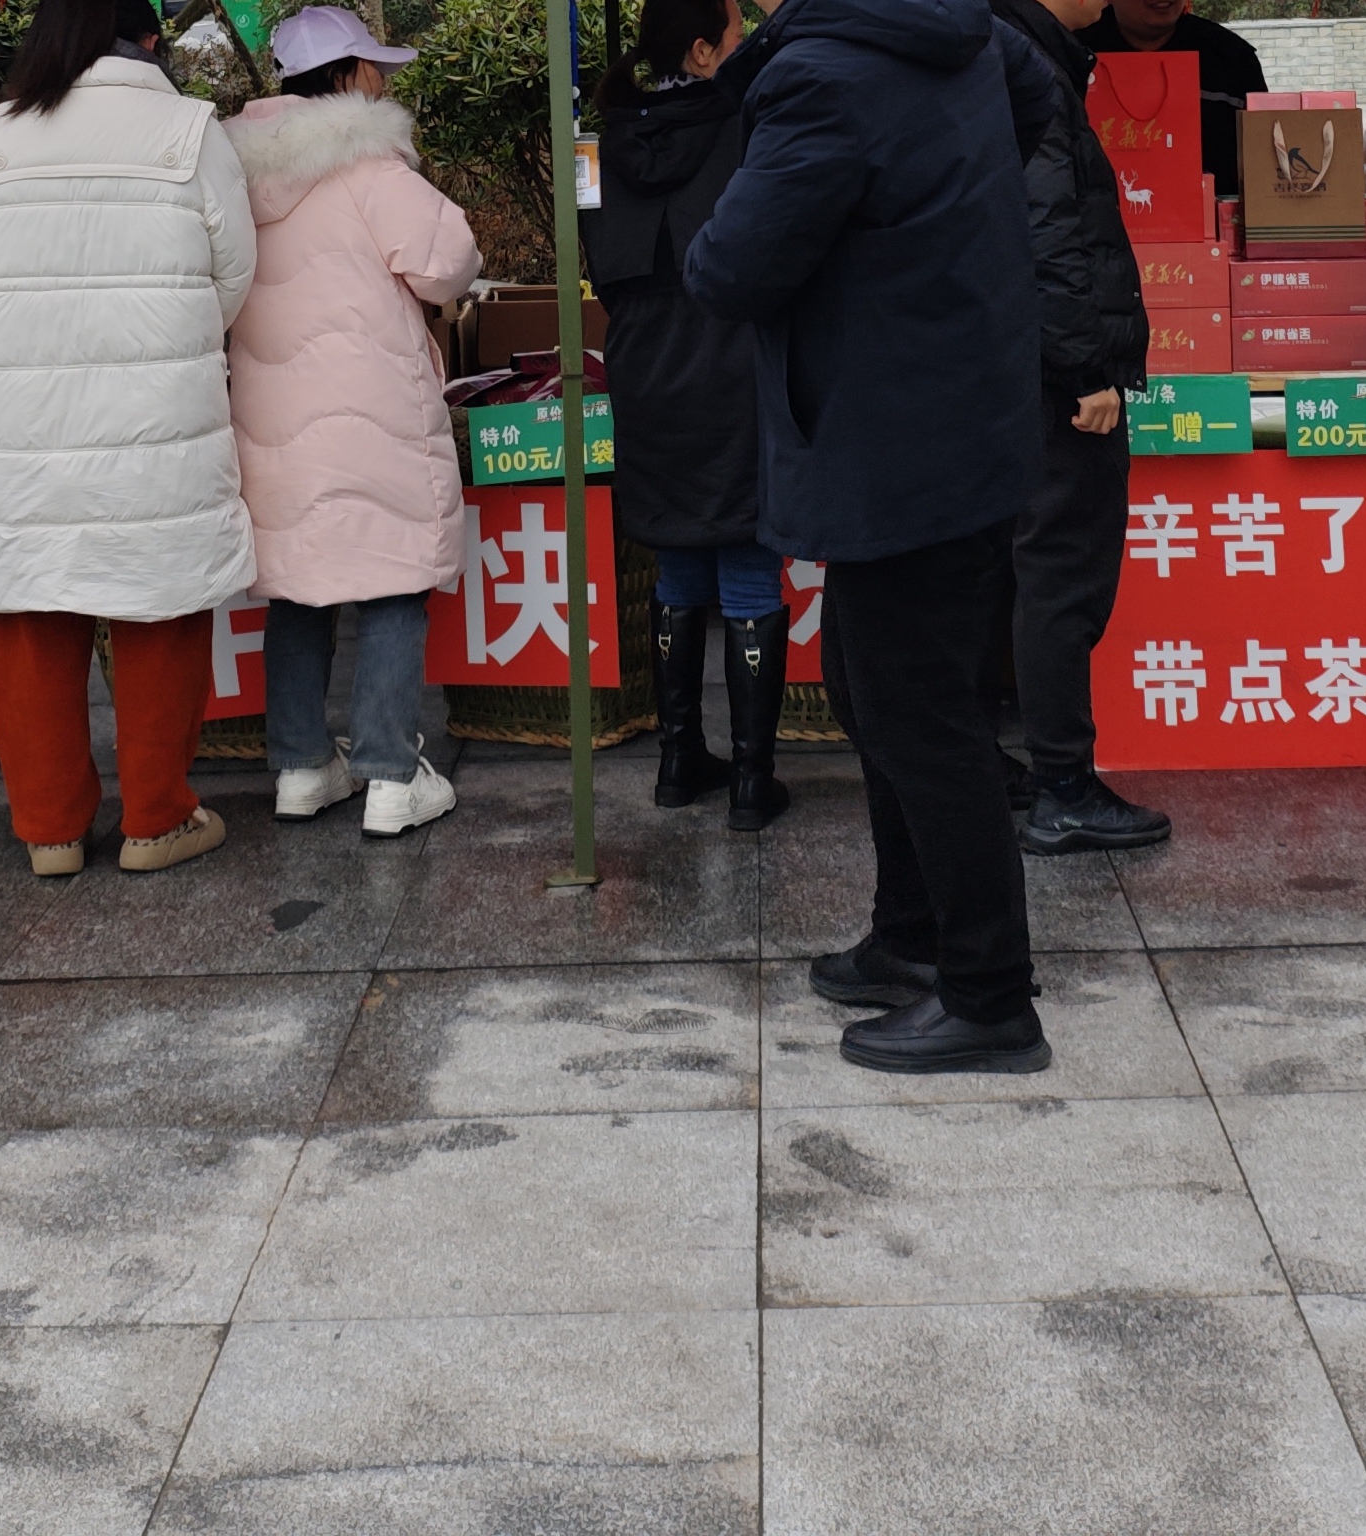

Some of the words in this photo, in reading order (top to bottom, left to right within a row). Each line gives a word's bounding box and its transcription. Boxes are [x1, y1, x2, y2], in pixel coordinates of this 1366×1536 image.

[1296, 398, 1339, 421] 特价
[479, 424, 521, 449] 特价
[1126, 410, 1238, 444] 一赠一
[439, 502, 598, 666] 快
